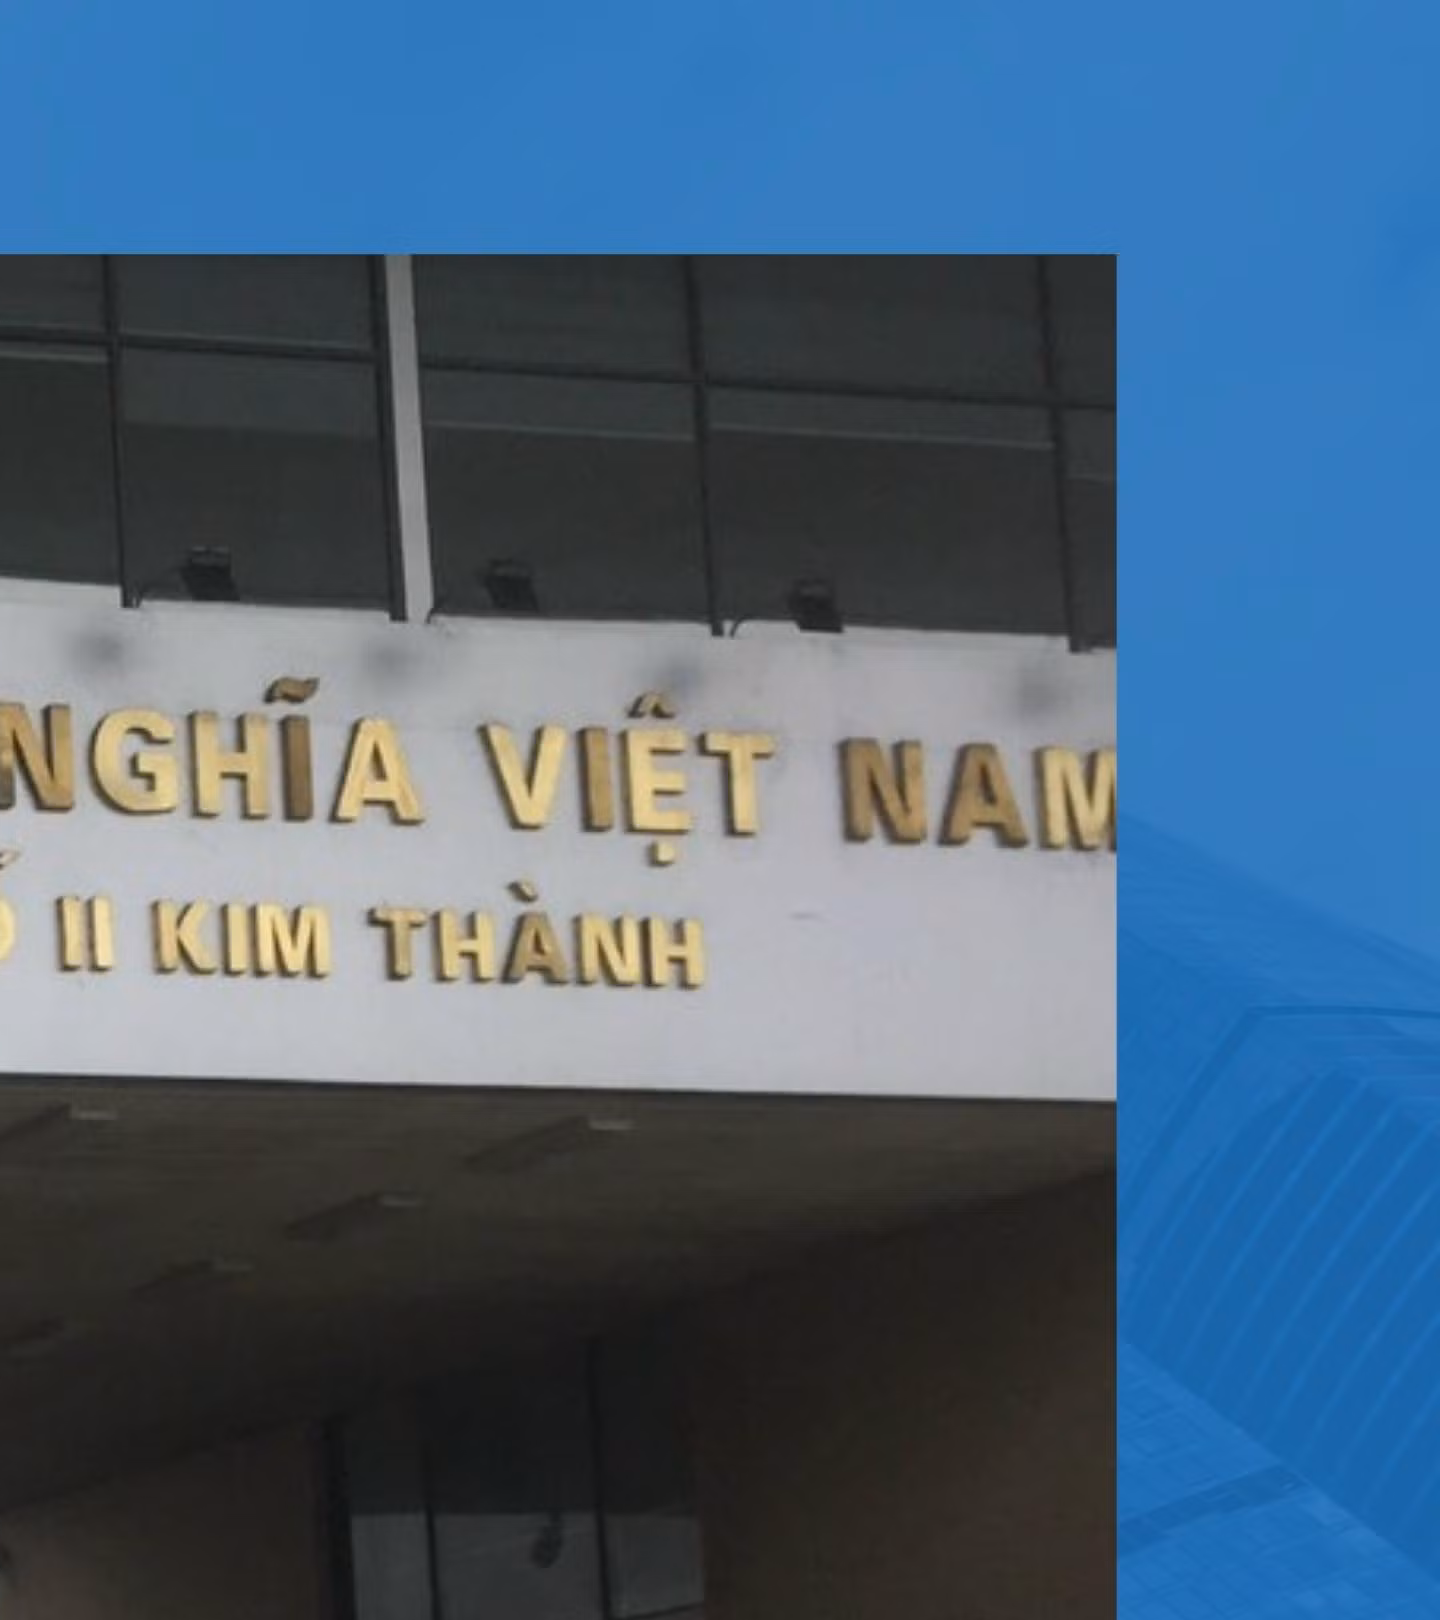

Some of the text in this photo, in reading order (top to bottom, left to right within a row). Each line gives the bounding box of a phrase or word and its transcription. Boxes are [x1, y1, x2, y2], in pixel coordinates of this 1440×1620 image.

[478, 691, 776, 866] VIỆT
[836, 737, 1117, 852] NAM
[55, 892, 115, 974] II
[150, 897, 333, 980] KIM
[365, 880, 707, 989] THÀNH
